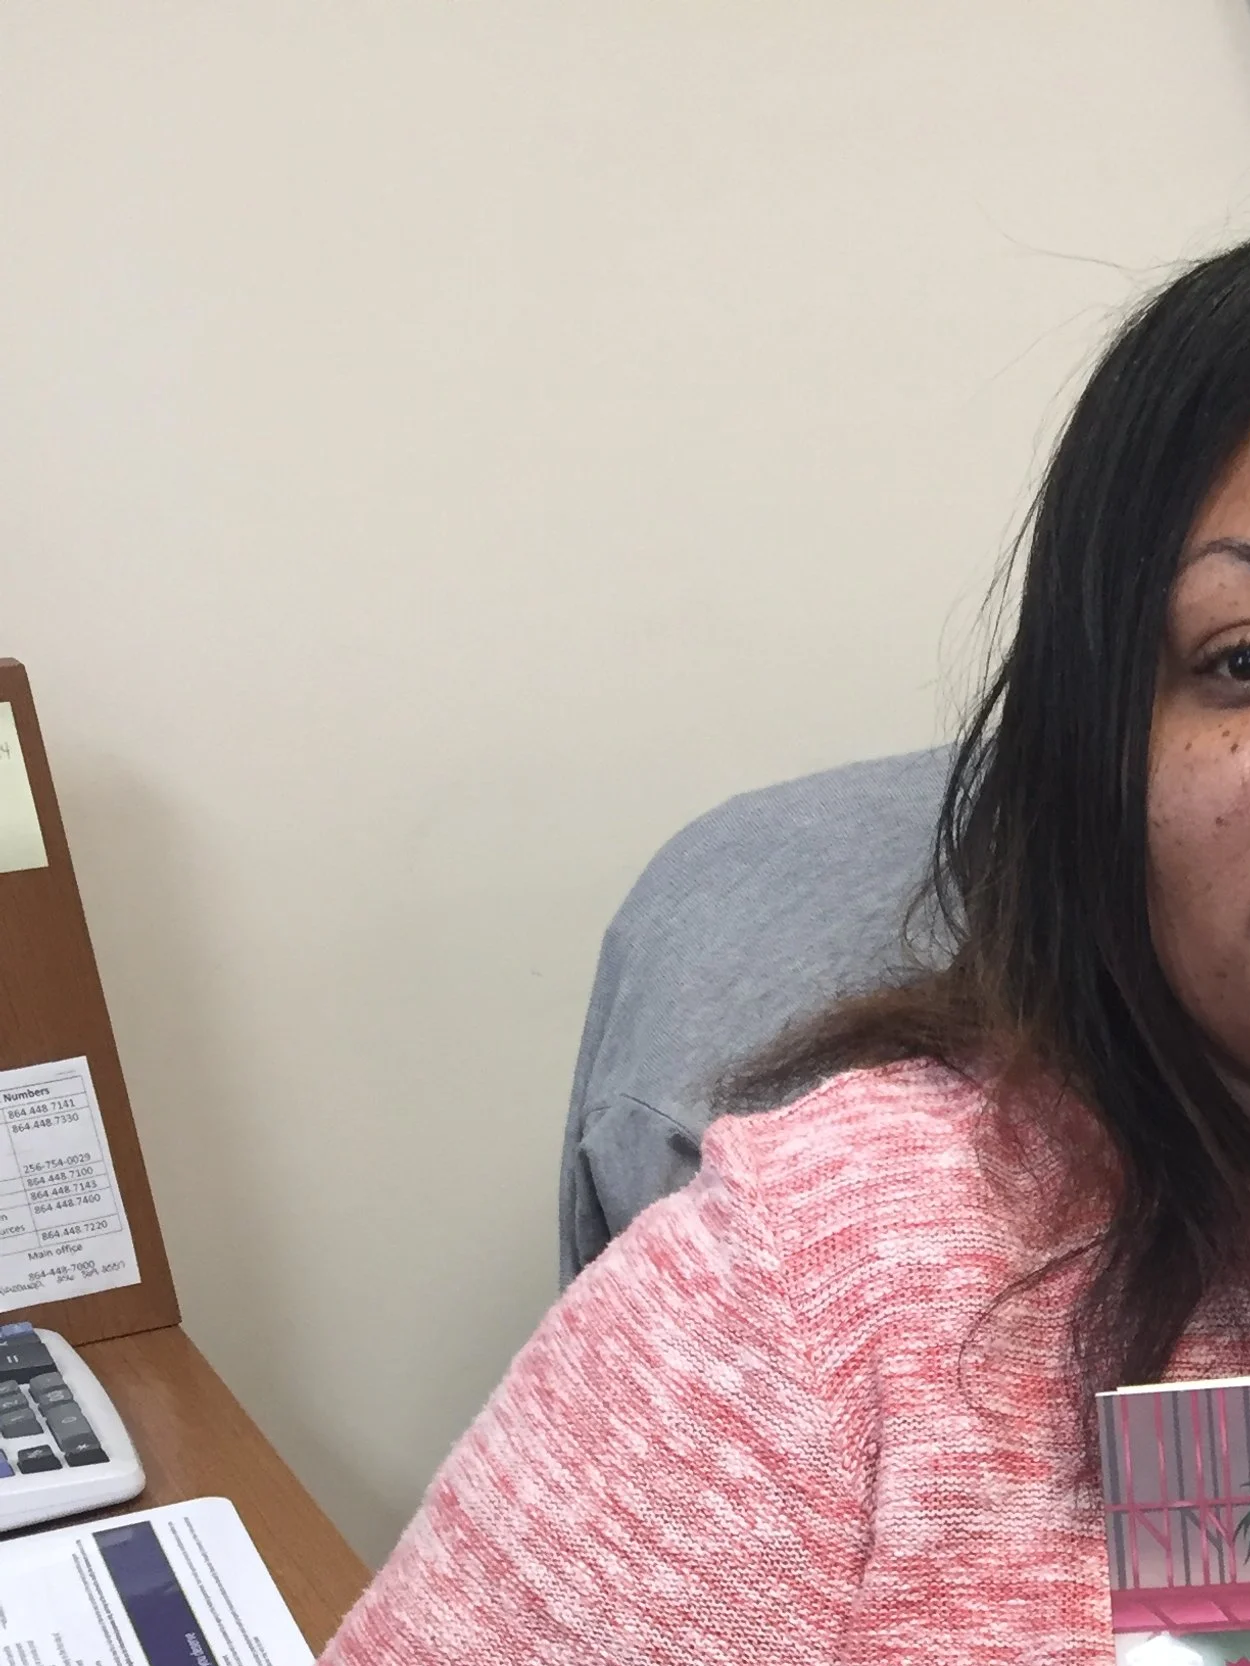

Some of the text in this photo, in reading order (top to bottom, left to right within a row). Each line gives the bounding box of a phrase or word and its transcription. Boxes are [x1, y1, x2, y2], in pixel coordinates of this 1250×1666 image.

[3, 1087, 50, 1103] Numbers
[28, 1243, 83, 1261] Main office
